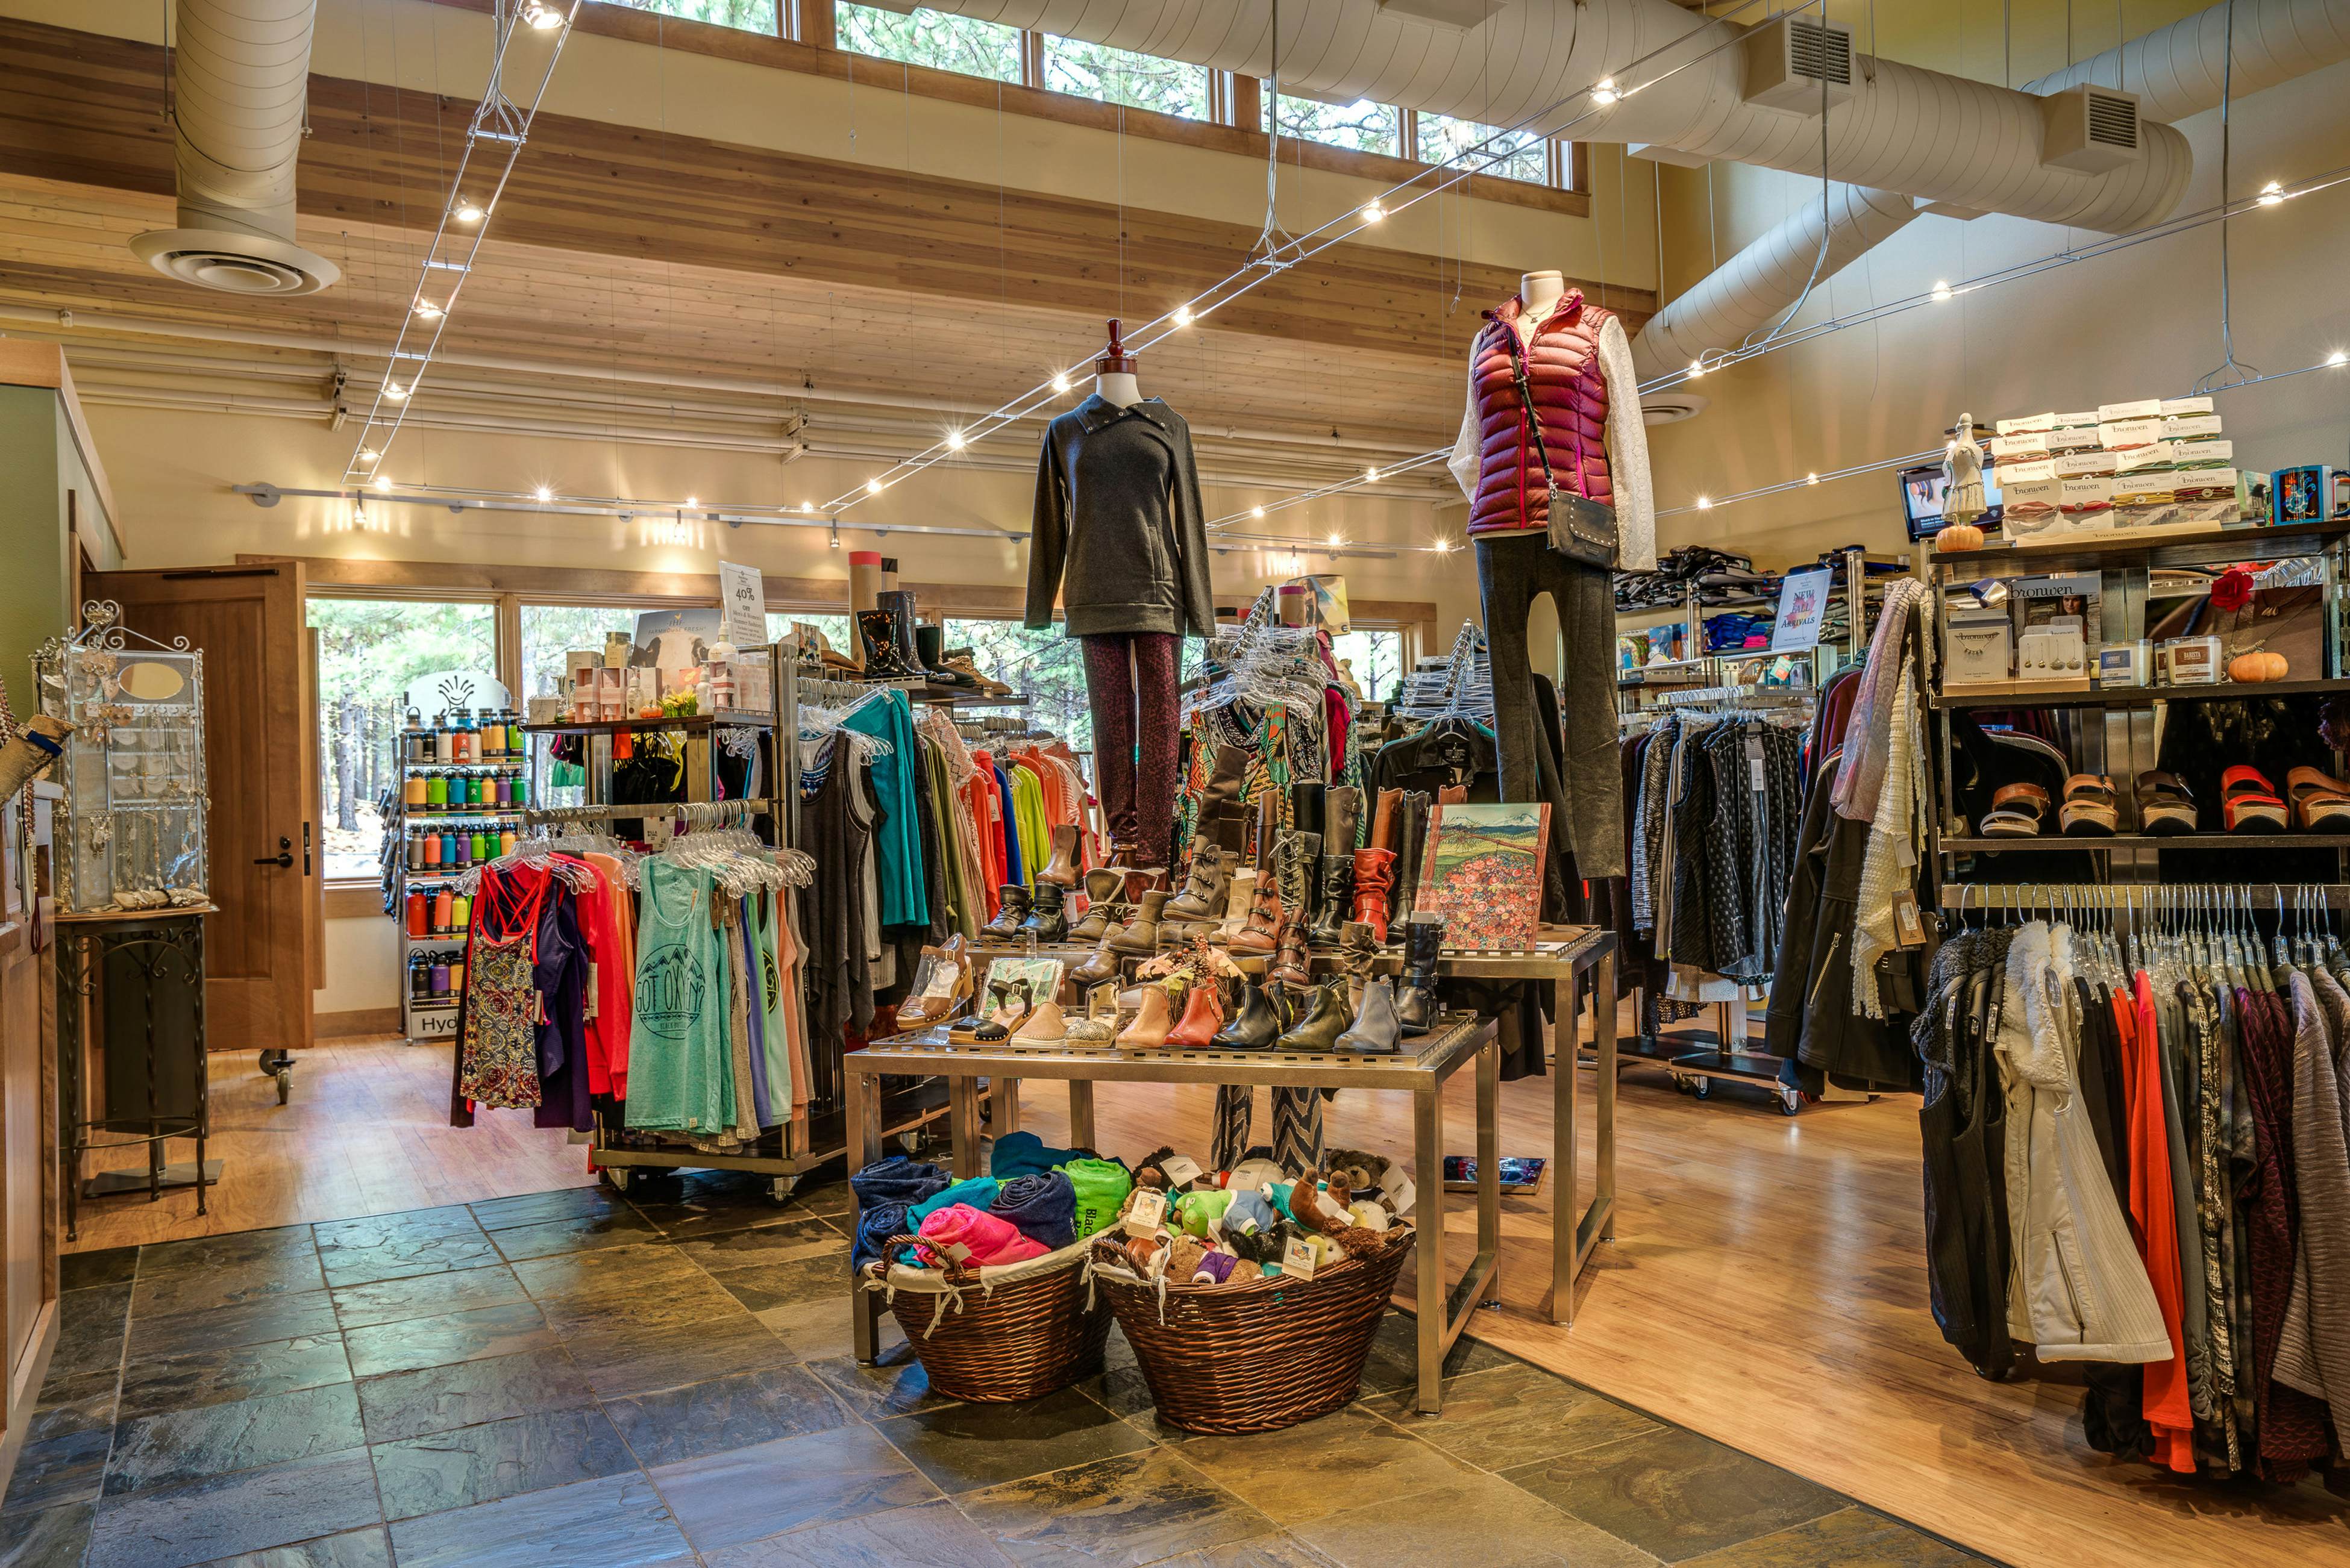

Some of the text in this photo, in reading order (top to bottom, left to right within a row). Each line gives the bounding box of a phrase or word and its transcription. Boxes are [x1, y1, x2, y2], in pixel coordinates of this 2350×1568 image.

[2008, 418, 2042, 426] bronwen
[2111, 424, 2149, 433] bronwen
[2169, 423, 2201, 433] bronwen
[2004, 438, 2038, 446] bronwen
[2055, 434, 2088, 443] bronwen
[2122, 448, 2160, 461] bronwen
[2178, 448, 2211, 457] bronwen
[2014, 464, 2049, 473] bronwen
[2066, 460, 2098, 468] bronwen
[2014, 484, 2049, 495] bronwen
[2064, 483, 2101, 492] bronwen
[736, 587, 754, 601] 40%
[1794, 590, 1814, 601] NEW
[2007, 584, 2075, 599] bronwen
[1792, 602, 1811, 613] FALL
[1781, 617, 1815, 628] ARRIVALS
[1958, 632, 1997, 640] bronwen
[636, 975, 659, 1013] GOT
